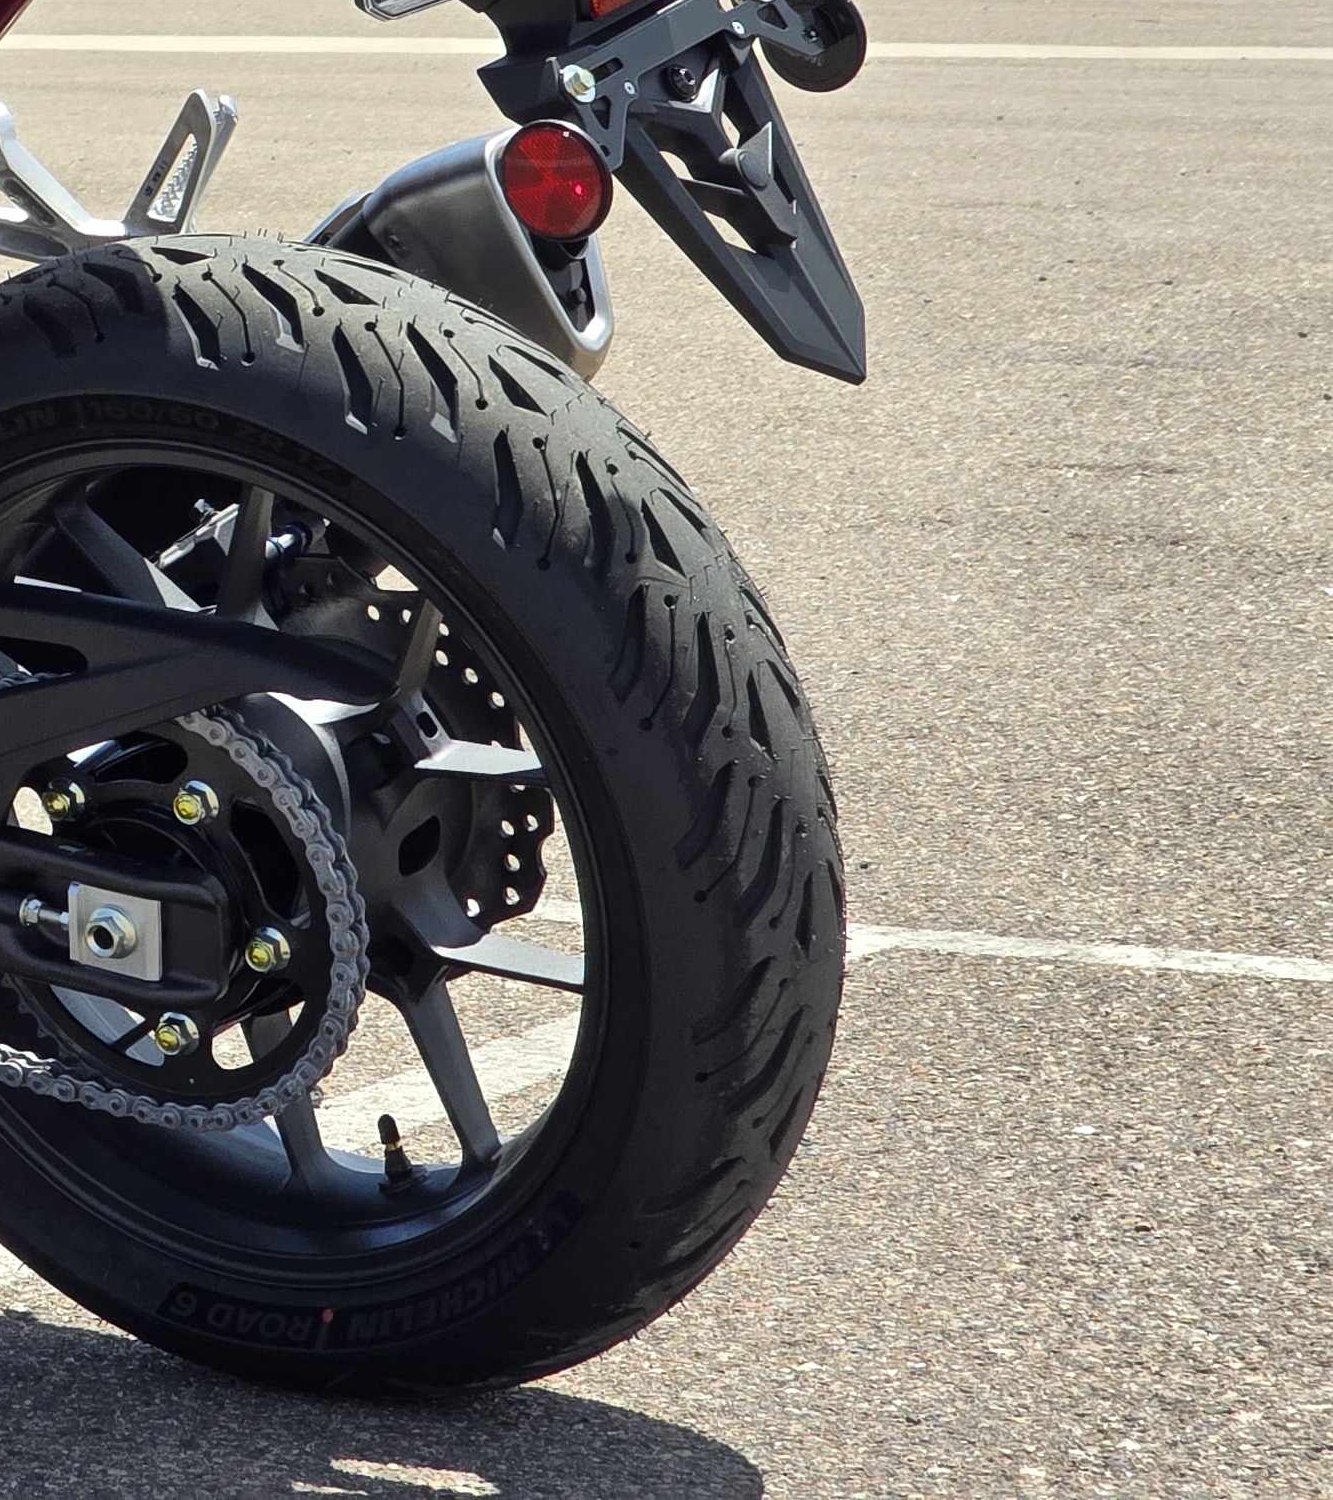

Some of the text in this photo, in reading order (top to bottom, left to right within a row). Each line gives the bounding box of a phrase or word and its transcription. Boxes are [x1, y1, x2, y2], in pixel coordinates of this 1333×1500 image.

[88, 399, 221, 432] 160/60
[170, 1248, 531, 1342] MICHELIN ROAD 6
